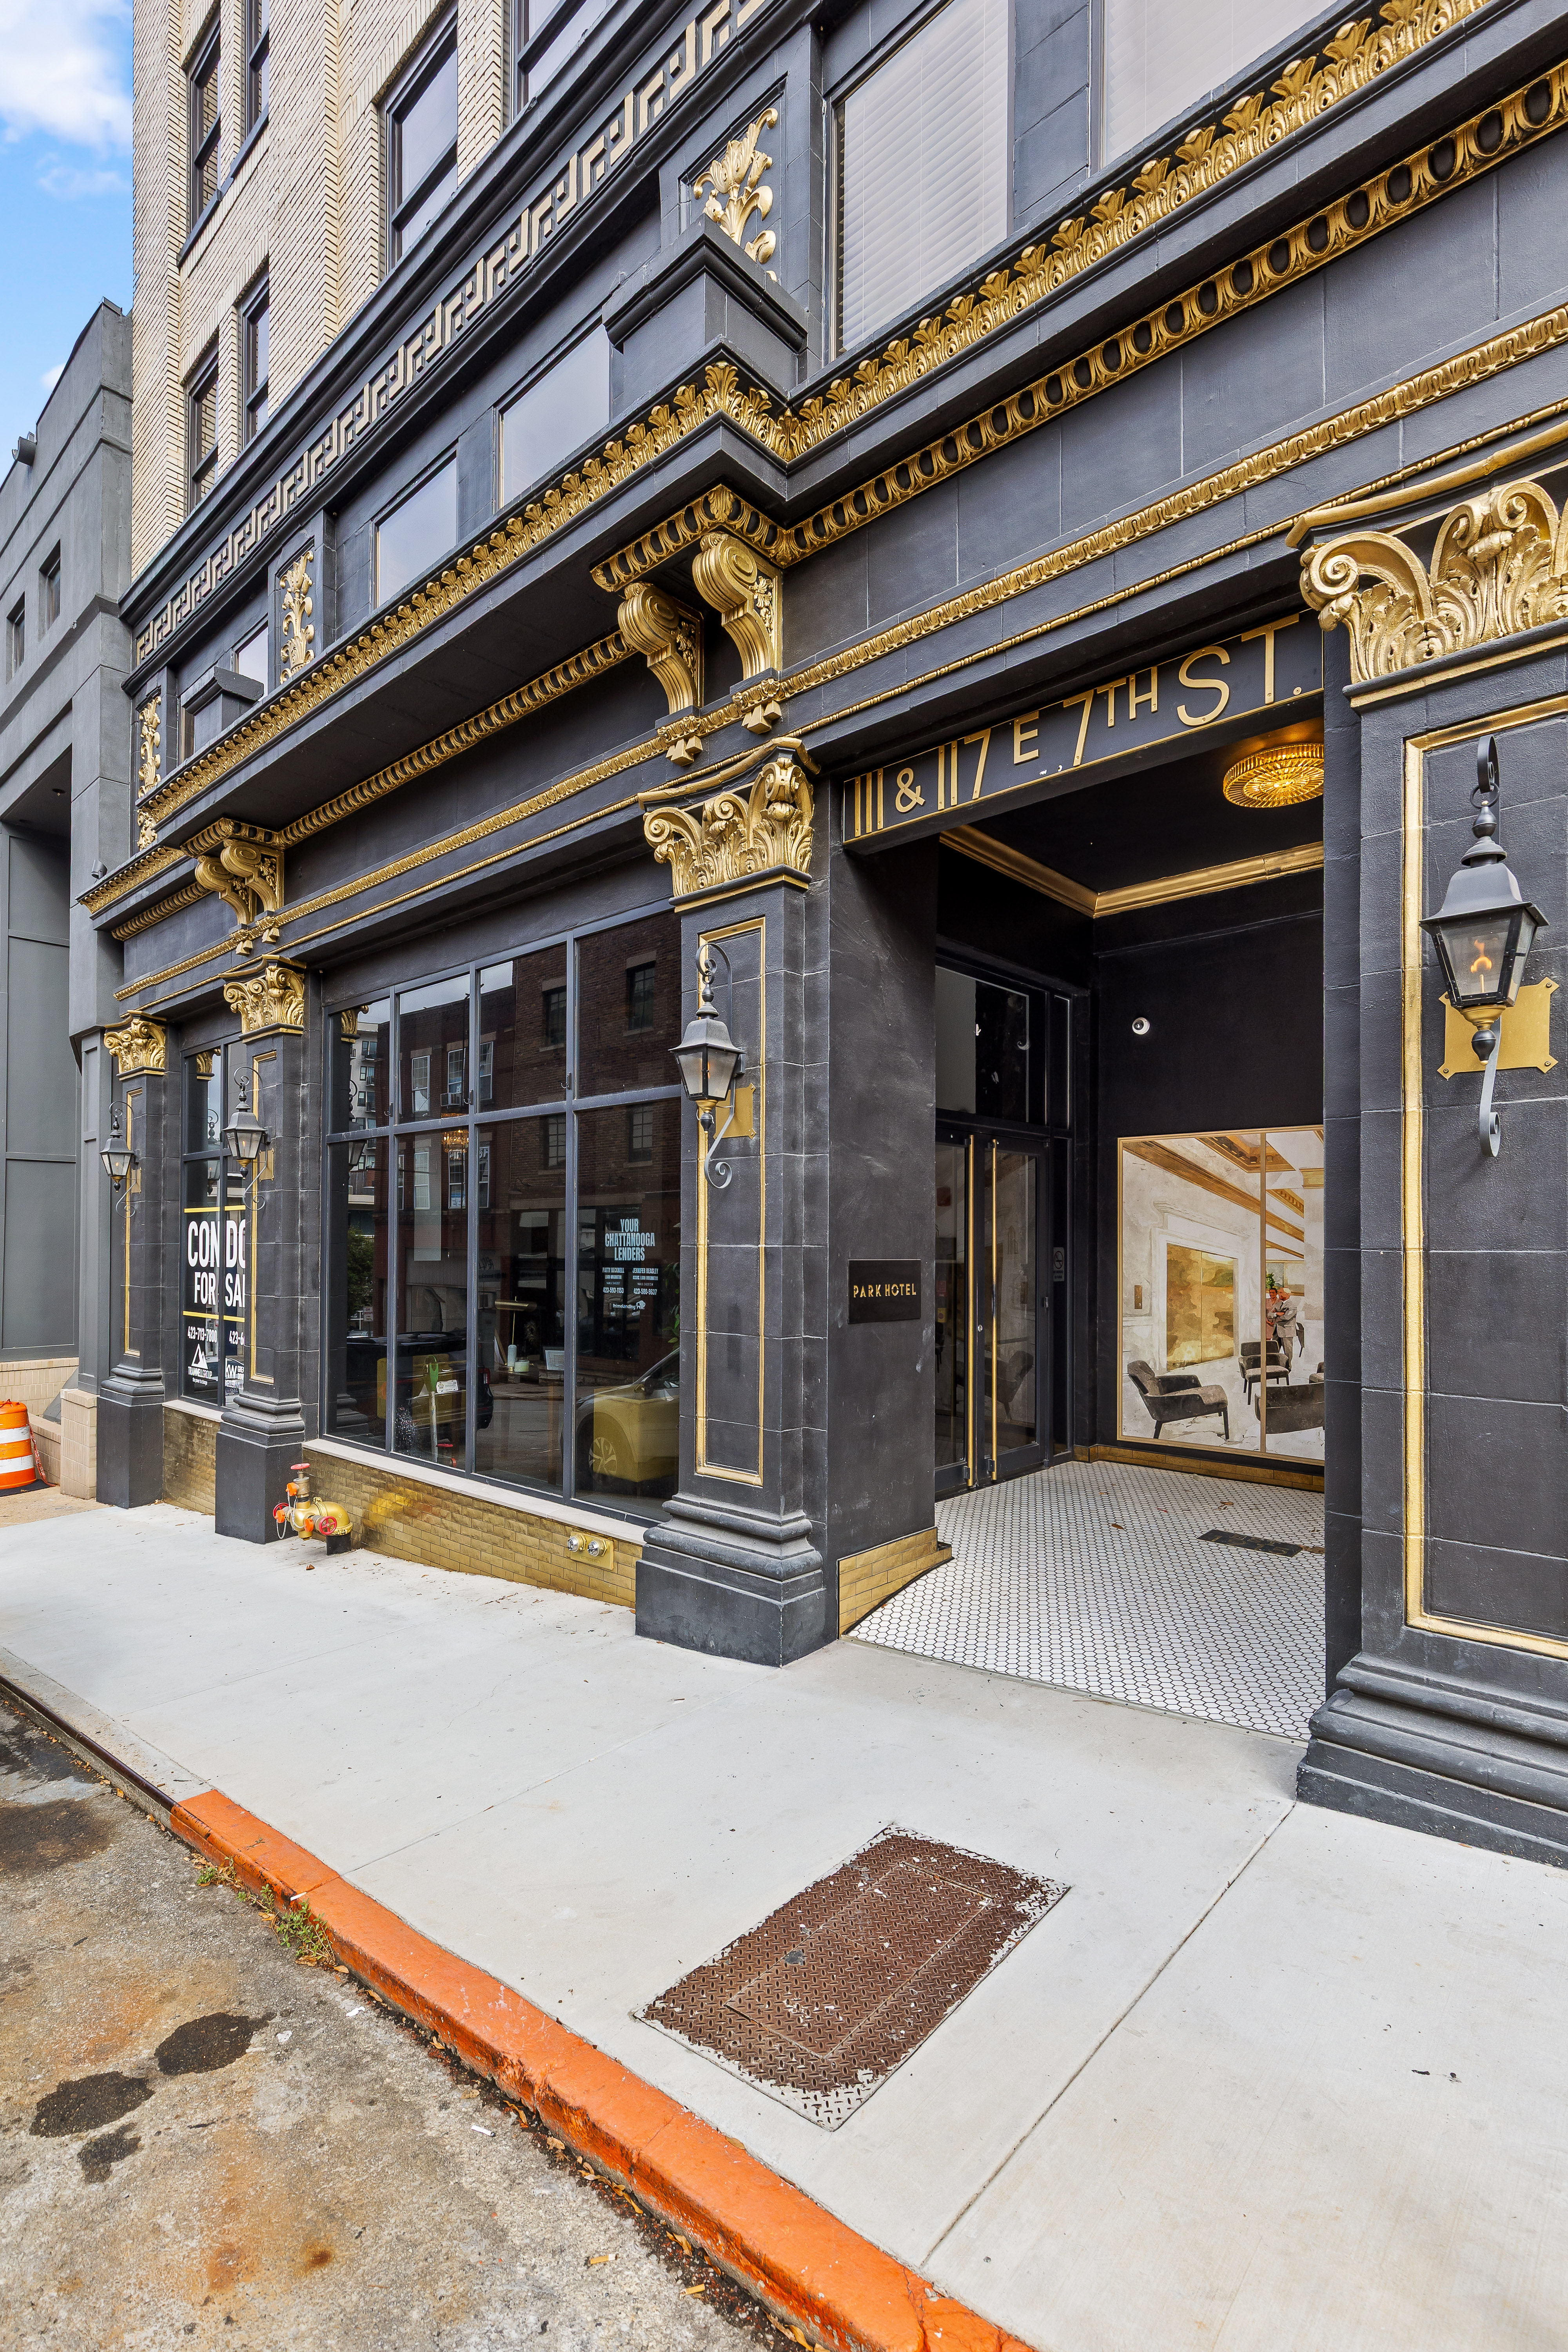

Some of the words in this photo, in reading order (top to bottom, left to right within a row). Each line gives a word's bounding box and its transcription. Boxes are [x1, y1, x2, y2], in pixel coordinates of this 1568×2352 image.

[855, 767, 884, 837] 111
[895, 767, 926, 813] &
[937, 728, 991, 810] 117
[1177, 613, 1303, 727] ST.
[620, 1218, 639, 1232] YOUR
[605, 1232, 655, 1247] CHATTANOOGA
[614, 1247, 645, 1261] LENDERS
[194, 1271, 216, 1305] FOR
[853, 1284, 882, 1298] PARK
[885, 1283, 916, 1296] HOTEL
[187, 1326, 217, 1343] 423-713-7800
